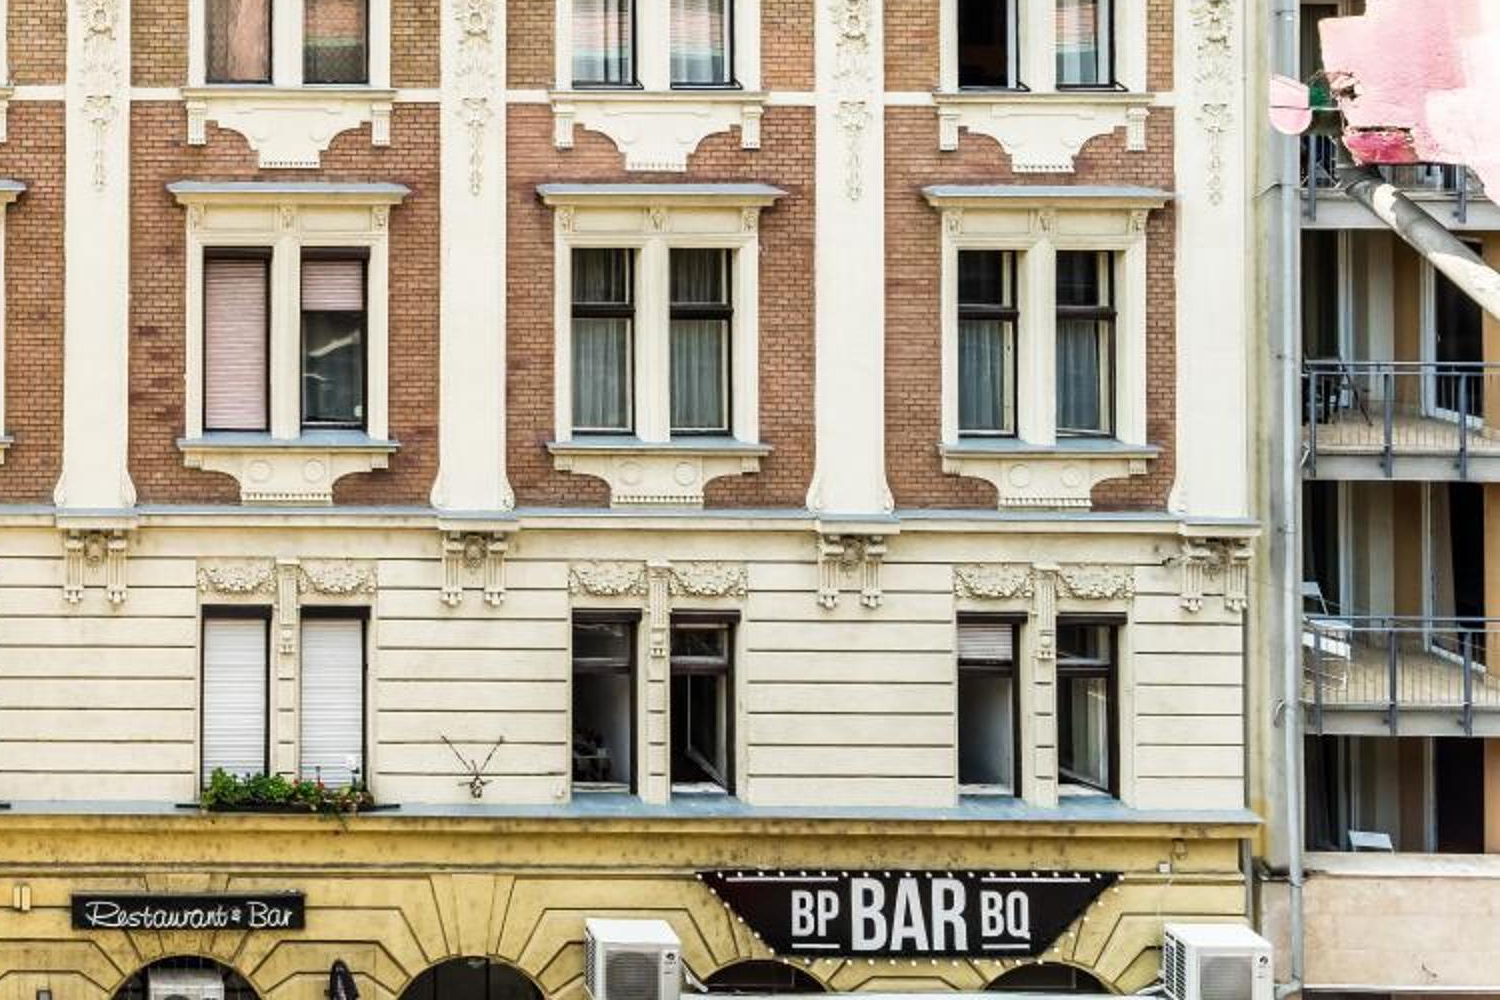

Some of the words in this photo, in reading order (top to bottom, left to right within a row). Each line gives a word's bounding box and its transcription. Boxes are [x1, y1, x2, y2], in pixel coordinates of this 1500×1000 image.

[85, 901, 228, 928] Restaurant
[246, 901, 293, 927] Bar
[791, 890, 840, 937] BP
[851, 877, 969, 951] BAR
[980, 890, 1031, 940] BQ
